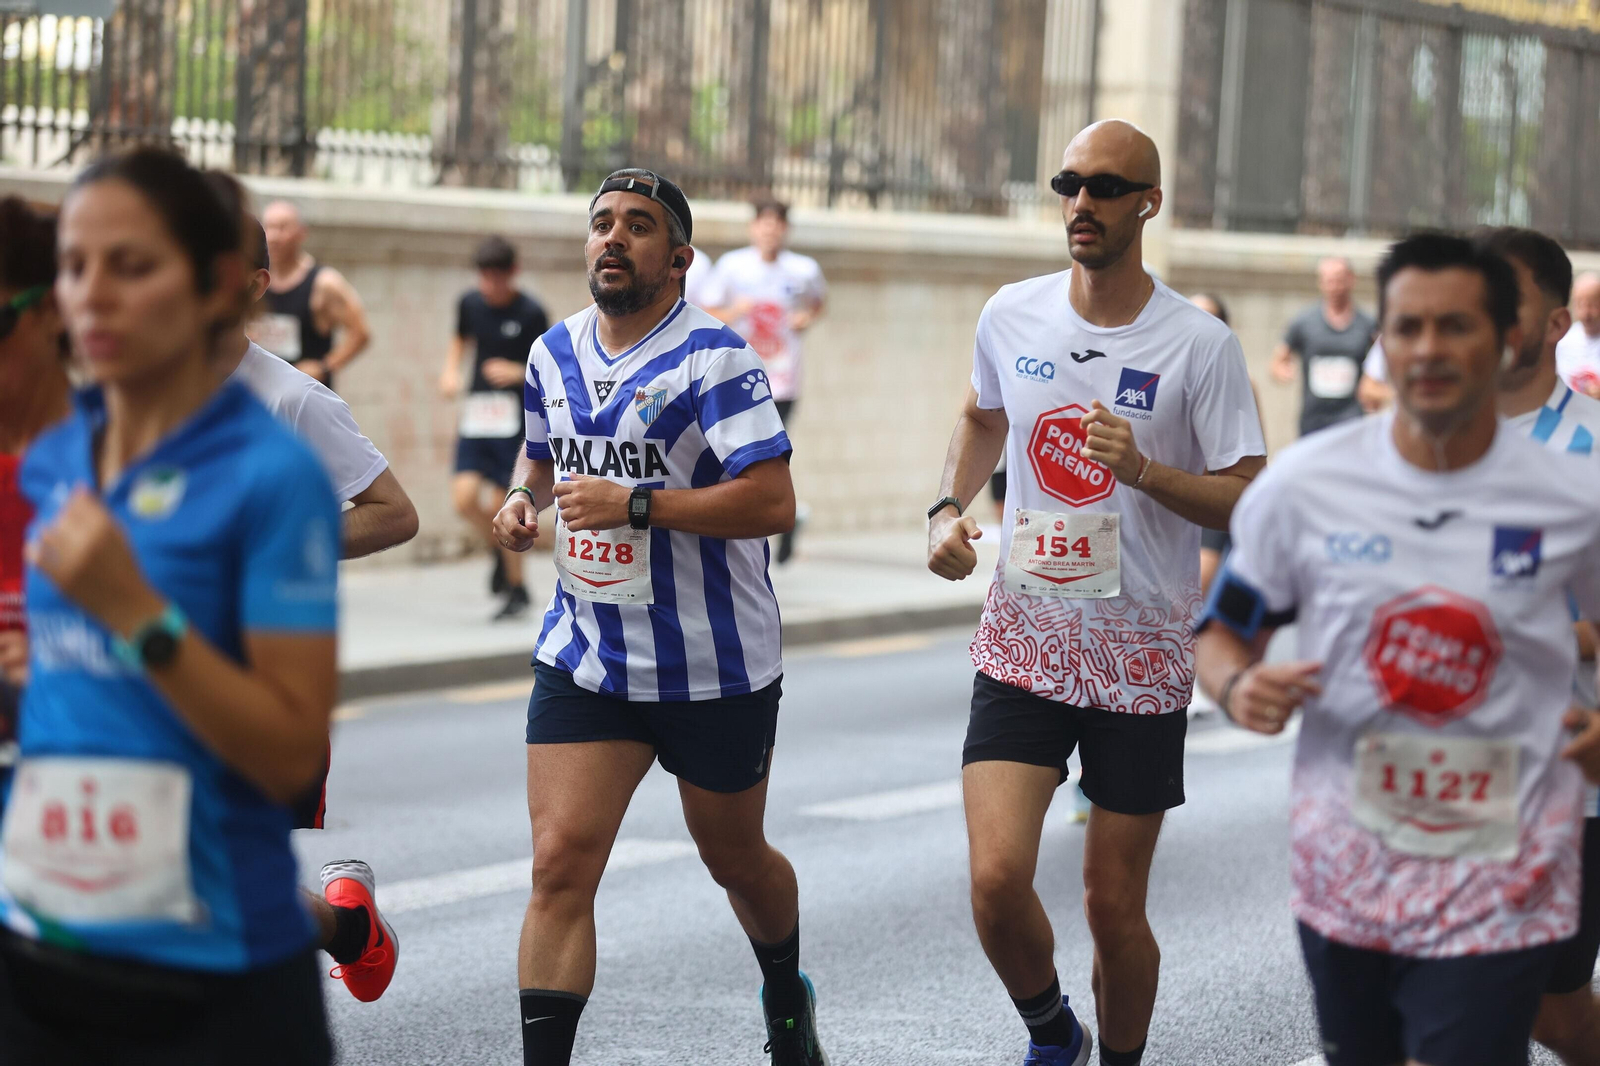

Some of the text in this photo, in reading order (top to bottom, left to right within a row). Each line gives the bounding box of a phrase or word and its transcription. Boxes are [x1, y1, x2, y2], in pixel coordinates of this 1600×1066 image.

[1113, 407, 1152, 421] fundación
[1115, 388, 1147, 407] AXA
[1039, 442, 1105, 486] FRENO
[568, 536, 634, 564] 1278
[1035, 534, 1091, 558] 154
[1389, 617, 1482, 667] PONLE
[1378, 642, 1477, 694] FRENO
[1382, 764, 1493, 802] 1127
